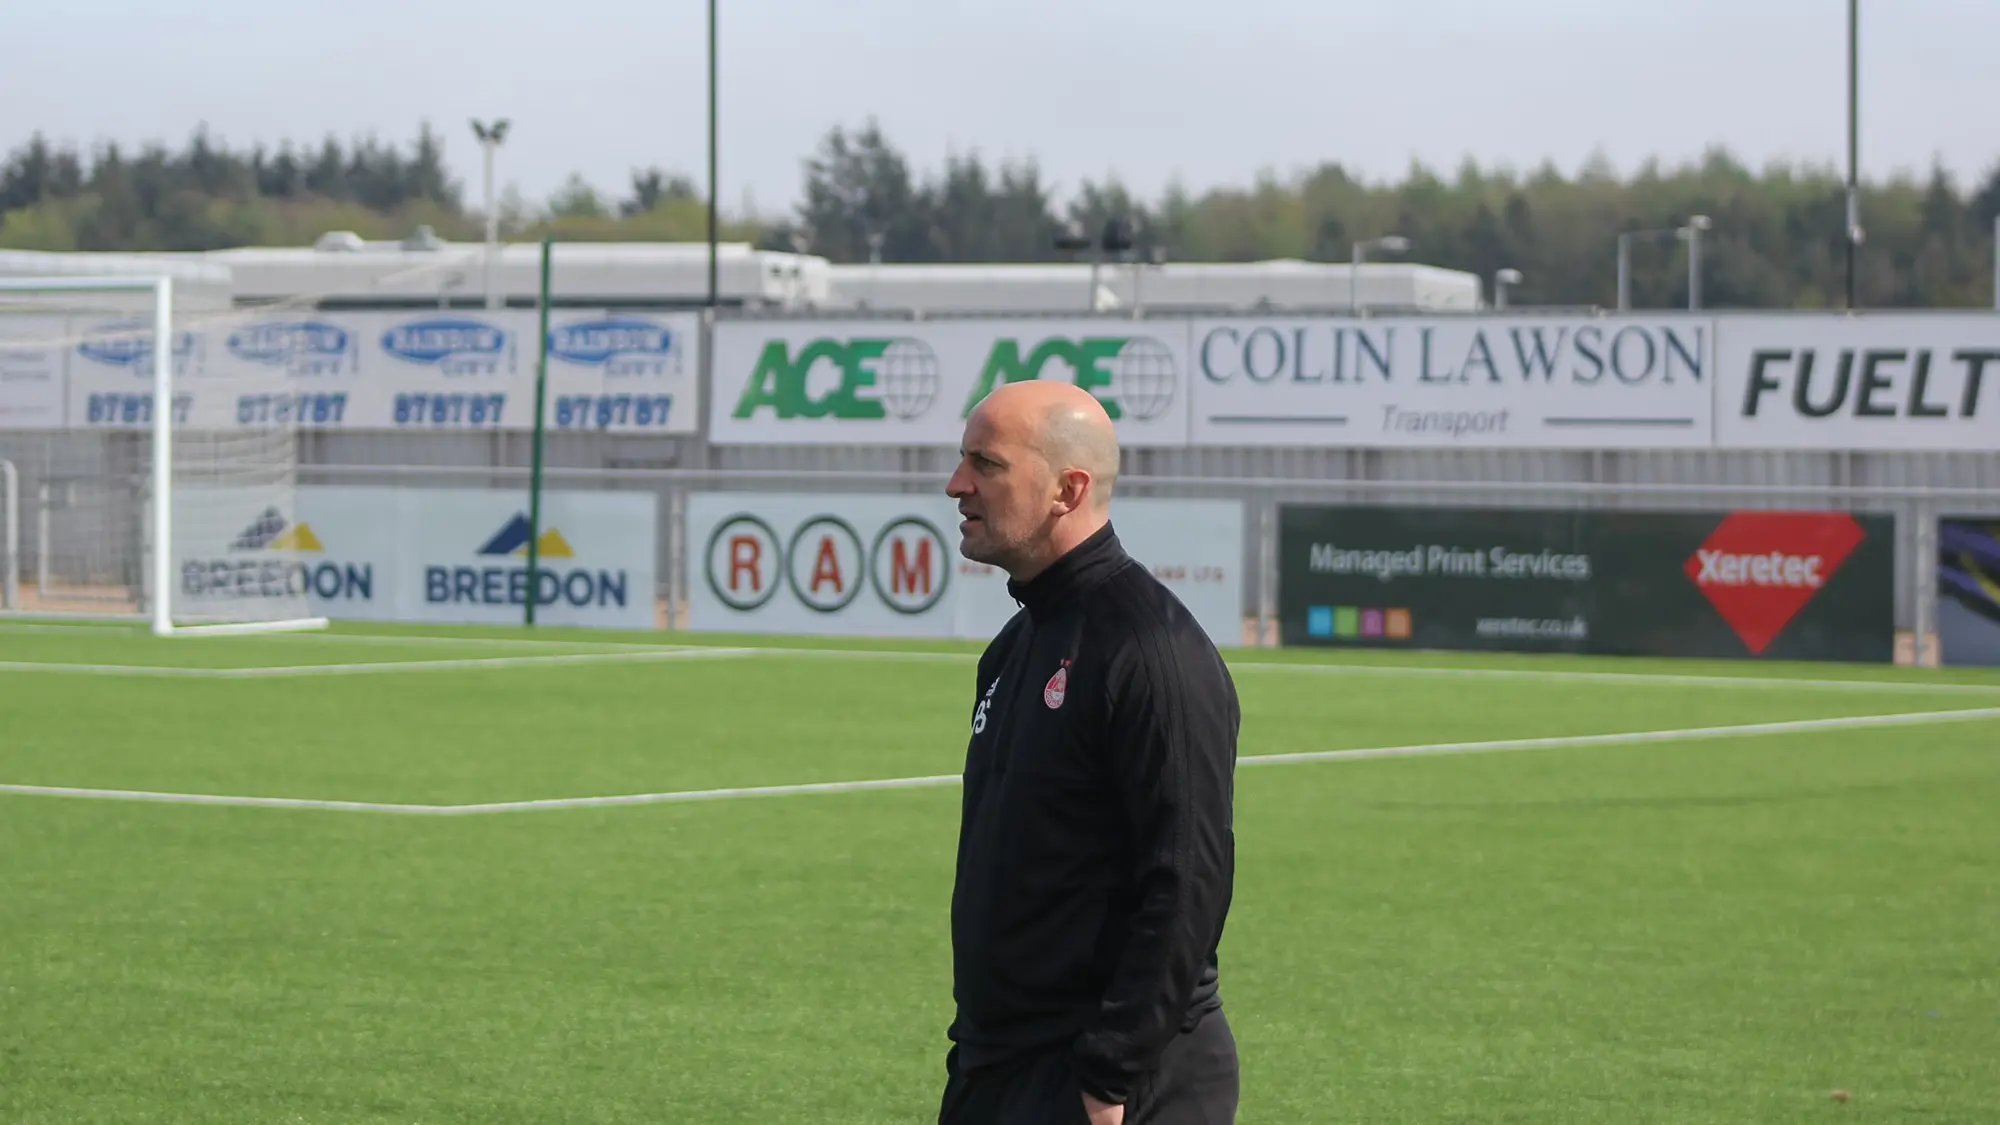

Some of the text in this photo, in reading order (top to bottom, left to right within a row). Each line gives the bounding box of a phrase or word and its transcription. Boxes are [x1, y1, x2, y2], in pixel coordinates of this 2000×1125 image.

[1200, 325, 1704, 385] COLIN LAWSON
[733, 337, 890, 419] ACE
[1741, 349, 2000, 418] FUELT
[87, 393, 193, 423] 87877
[394, 392, 506, 423] 878787
[555, 393, 672, 426] 878787
[1381, 404, 1510, 438] Transport
[181, 557, 372, 600] BREEDON
[1310, 542, 1590, 582] Managed Print Services
[1697, 548, 1823, 587] Xeretec
[426, 564, 627, 607] BREEDON
